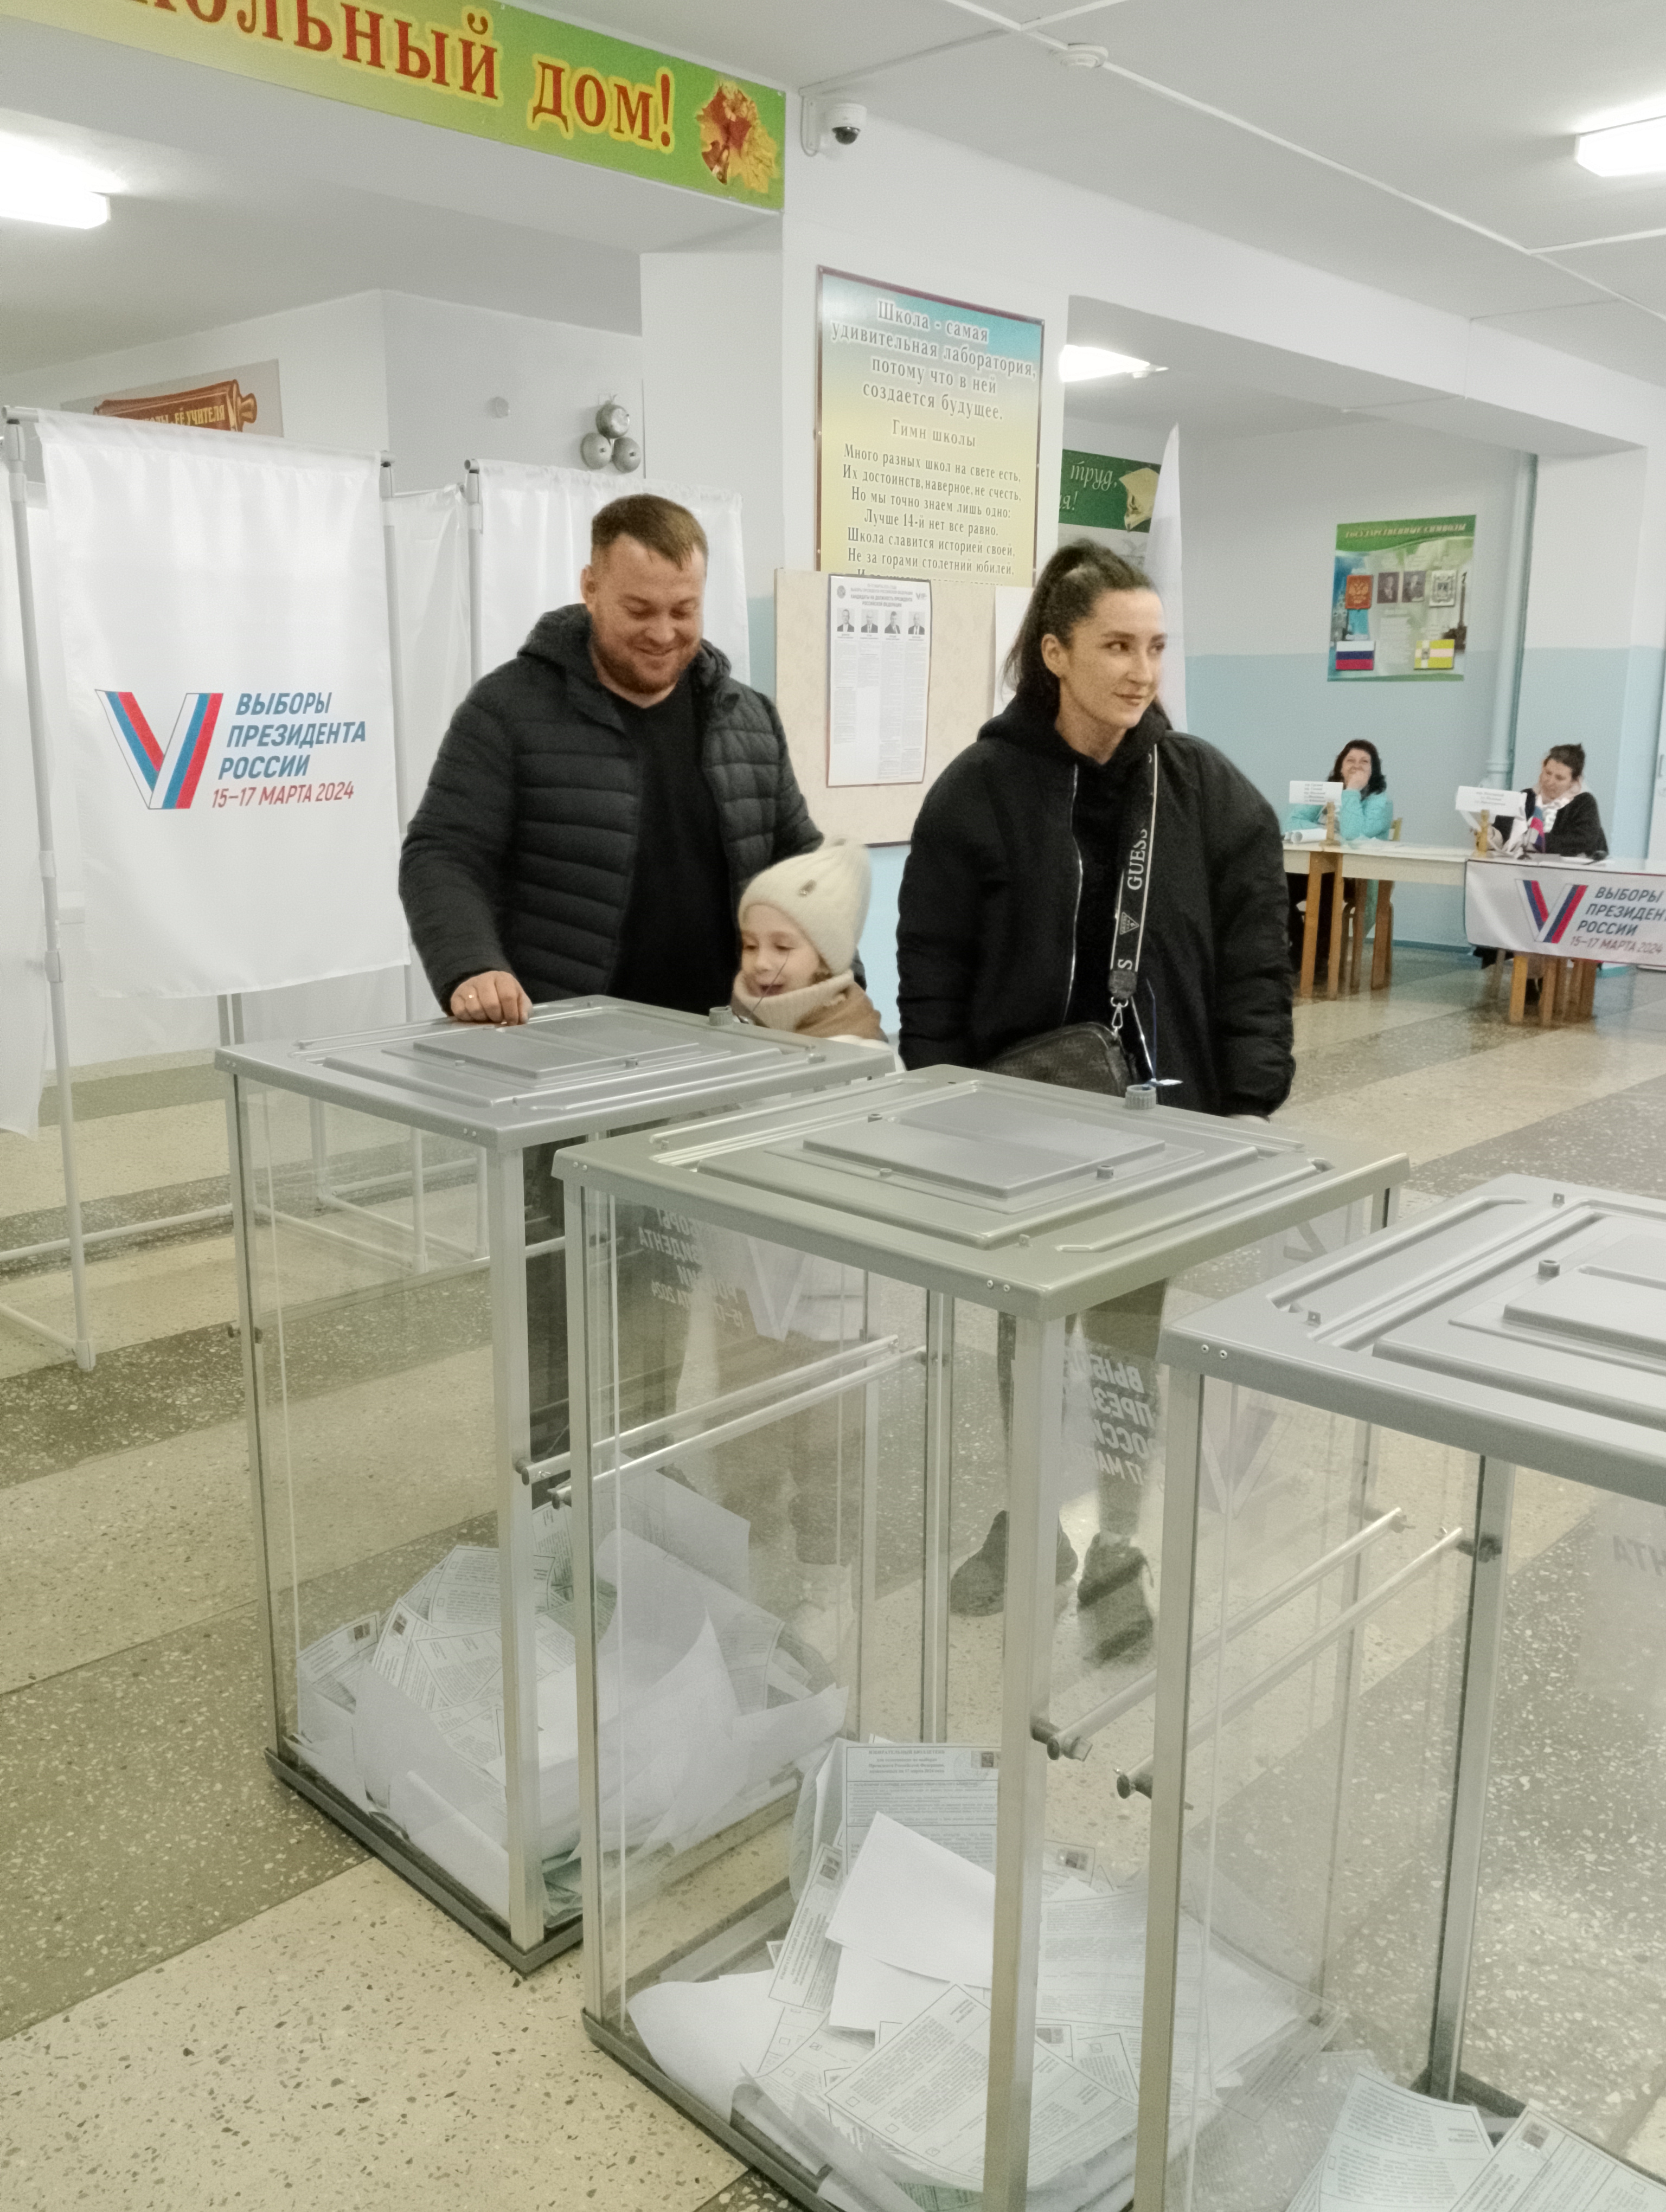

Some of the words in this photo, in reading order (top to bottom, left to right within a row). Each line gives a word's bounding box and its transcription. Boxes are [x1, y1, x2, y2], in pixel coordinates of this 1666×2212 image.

[878, 300, 929, 329] Школа
[946, 321, 988, 342] самая
[832, 322, 937, 357] удивительная
[944, 346, 1036, 378] лаборатория,
[872, 358, 924, 384] потому
[930, 371, 953, 385] что
[960, 375, 966, 388] в
[972, 376, 996, 394] ней
[186, 405, 225, 425] УЧИТЕЛЯ
[863, 383, 935, 408] создается
[941, 394, 1003, 420] будущее.
[892, 419, 926, 439] Гимн
[932, 430, 976, 447] школы
[844, 443, 879, 461] Много
[882, 453, 921, 468] разных
[926, 459, 951, 472] школ
[955, 464, 966, 475] на
[970, 466, 995, 478] свете
[999, 471, 1021, 483] есть,
[843, 464, 858, 480] Их
[989, 488, 1021, 501] счесть,
[851, 486, 866, 501] Но
[870, 492, 886, 504] мы
[890, 494, 920, 508] точно
[924, 499, 953, 512] знаем
[957, 503, 982, 516] лишь
[985, 507, 1010, 518] одно:
[864, 509, 899, 526] Лучше
[903, 513, 924, 529] 14-й
[928, 519, 945, 531] нет
[949, 521, 964, 533] все
[968, 524, 998, 537] равно.
[847, 527, 884, 544] Школа
[888, 535, 934, 549] славится
[938, 541, 983, 556] историей
[986, 544, 1015, 557] своей,
[848, 548, 862, 562] Не
[866, 552, 877, 564] за
[881, 555, 918, 569] горами
[922, 558, 972, 573] столетний
[976, 560, 1014, 576] юбилей,
[235, 692, 332, 715] ВЫБОРЫ
[227, 721, 366, 749] ПРЕЗИДЕНТА
[218, 754, 311, 780] РОССИИ
[258, 784, 312, 805] МАРТА
[315, 781, 354, 802] 2024
[1595, 886, 1664, 903] ВЫБОРЫ
[1585, 903, 1666, 921] ПРЕЗИДЕН
[1577, 920, 1638, 936] РОССИИ
[1600, 939, 1636, 951] МАРТА
[1637, 942, 1663, 954] 2024
